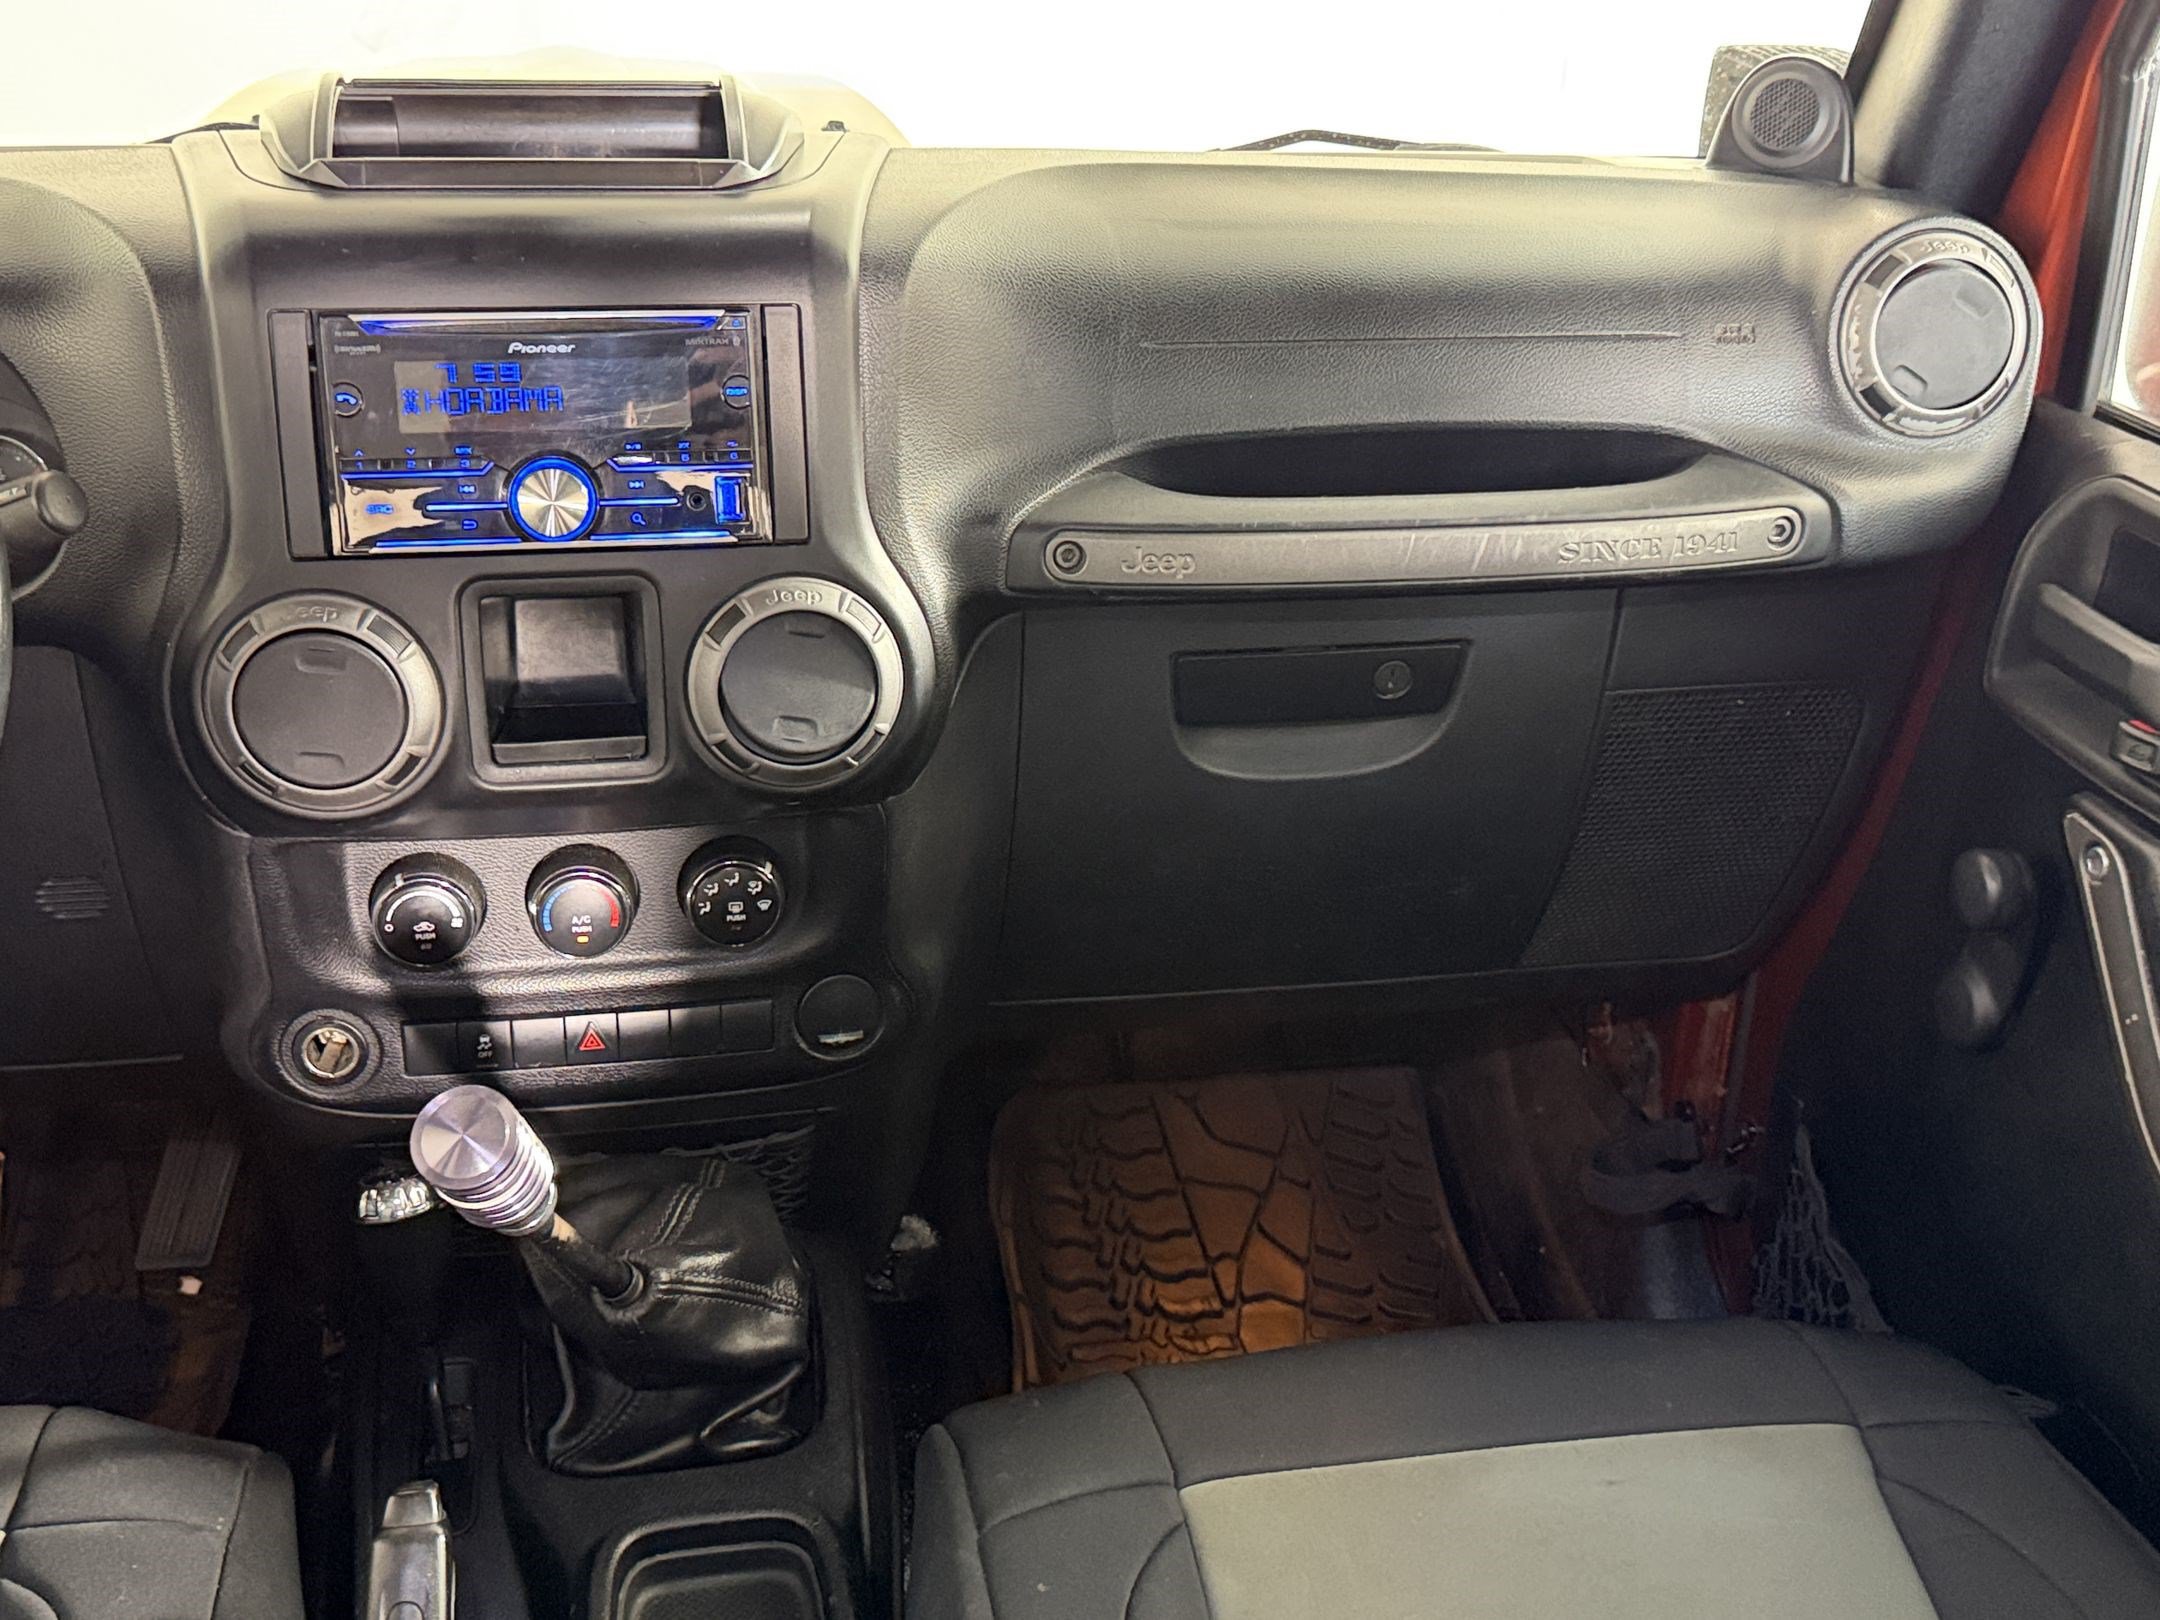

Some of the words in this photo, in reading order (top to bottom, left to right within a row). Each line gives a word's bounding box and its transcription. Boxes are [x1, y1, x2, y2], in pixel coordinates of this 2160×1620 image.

[508, 341, 576, 354] Pioneer
[1558, 537, 1663, 565] SINCE
[1674, 531, 1739, 557] 1941
[1121, 546, 1197, 580] Jeep
[766, 589, 823, 606] Jeep
[283, 606, 339, 623] eep
[571, 914, 592, 924] A/C
[726, 914, 747, 922] PUSH
[415, 932, 436, 941] PUSH
[477, 1050, 493, 1058] OFF
